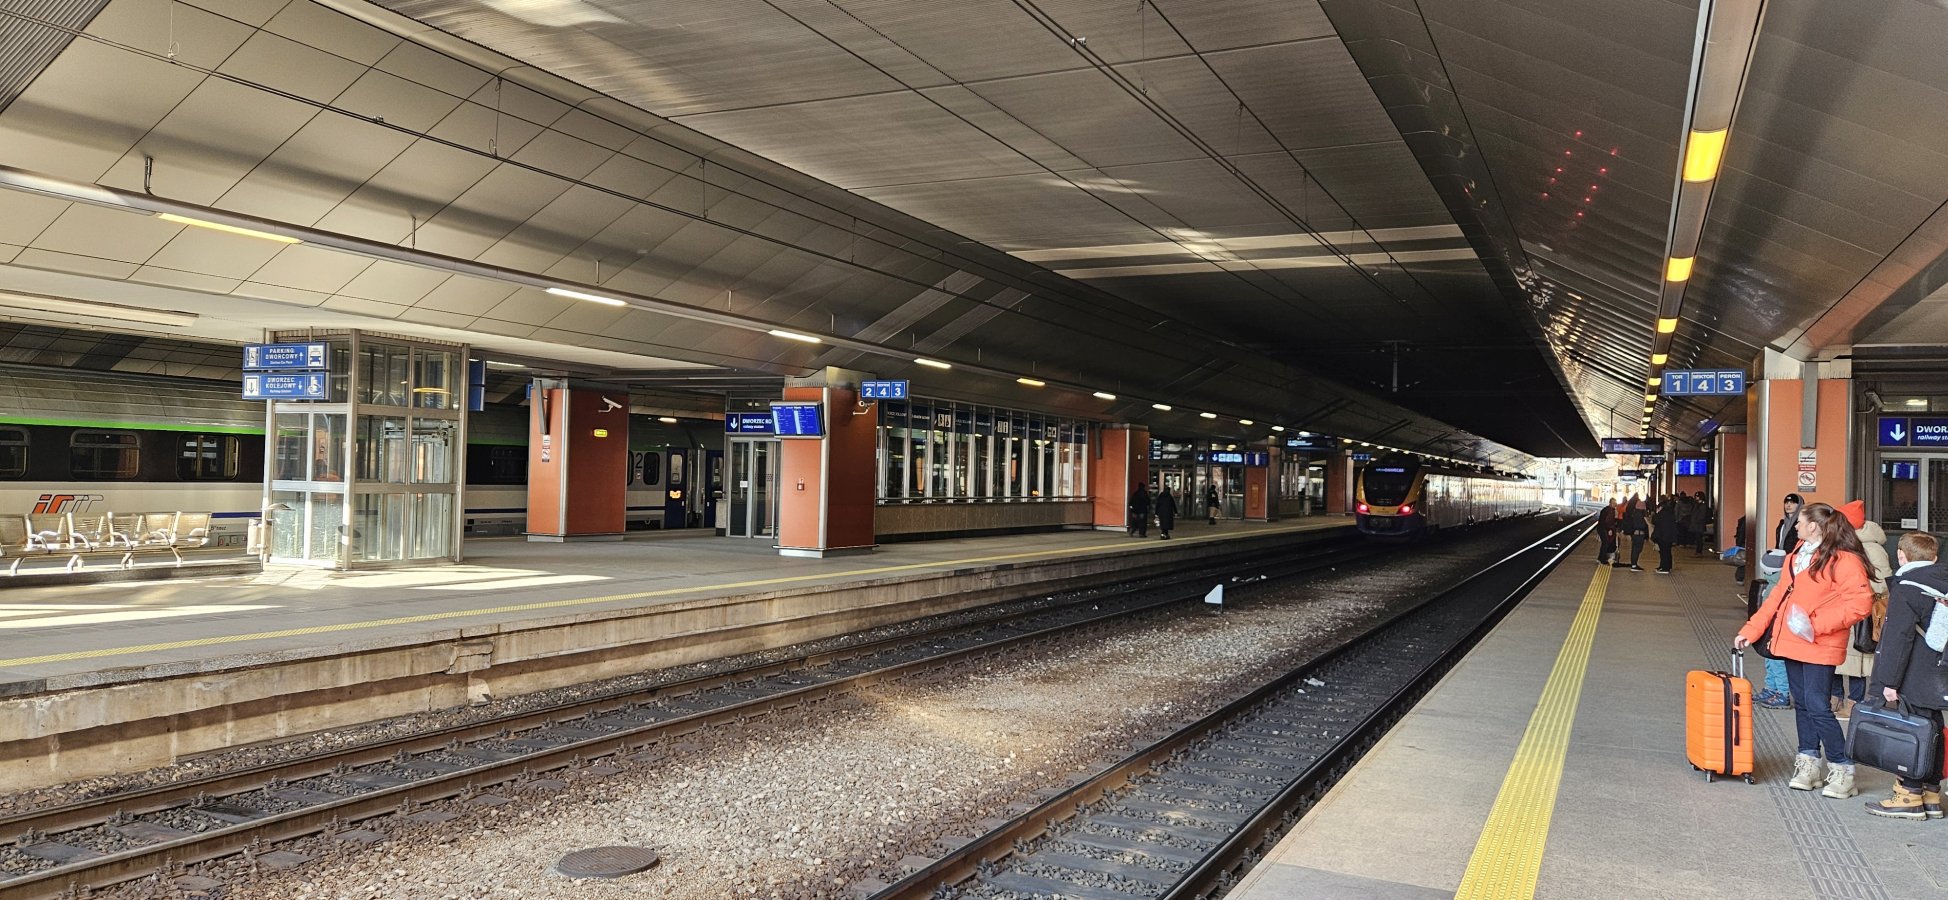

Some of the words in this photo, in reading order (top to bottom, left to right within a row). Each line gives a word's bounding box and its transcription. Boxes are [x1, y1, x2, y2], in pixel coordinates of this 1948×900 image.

[1672, 380, 1680, 391] 1
[1697, 380, 1708, 391] 4
[1724, 380, 1734, 391] 3
[866, 388, 872, 396] 2
[880, 388, 886, 396] 4
[895, 388, 901, 396] 3
[635, 452, 643, 468] 2
